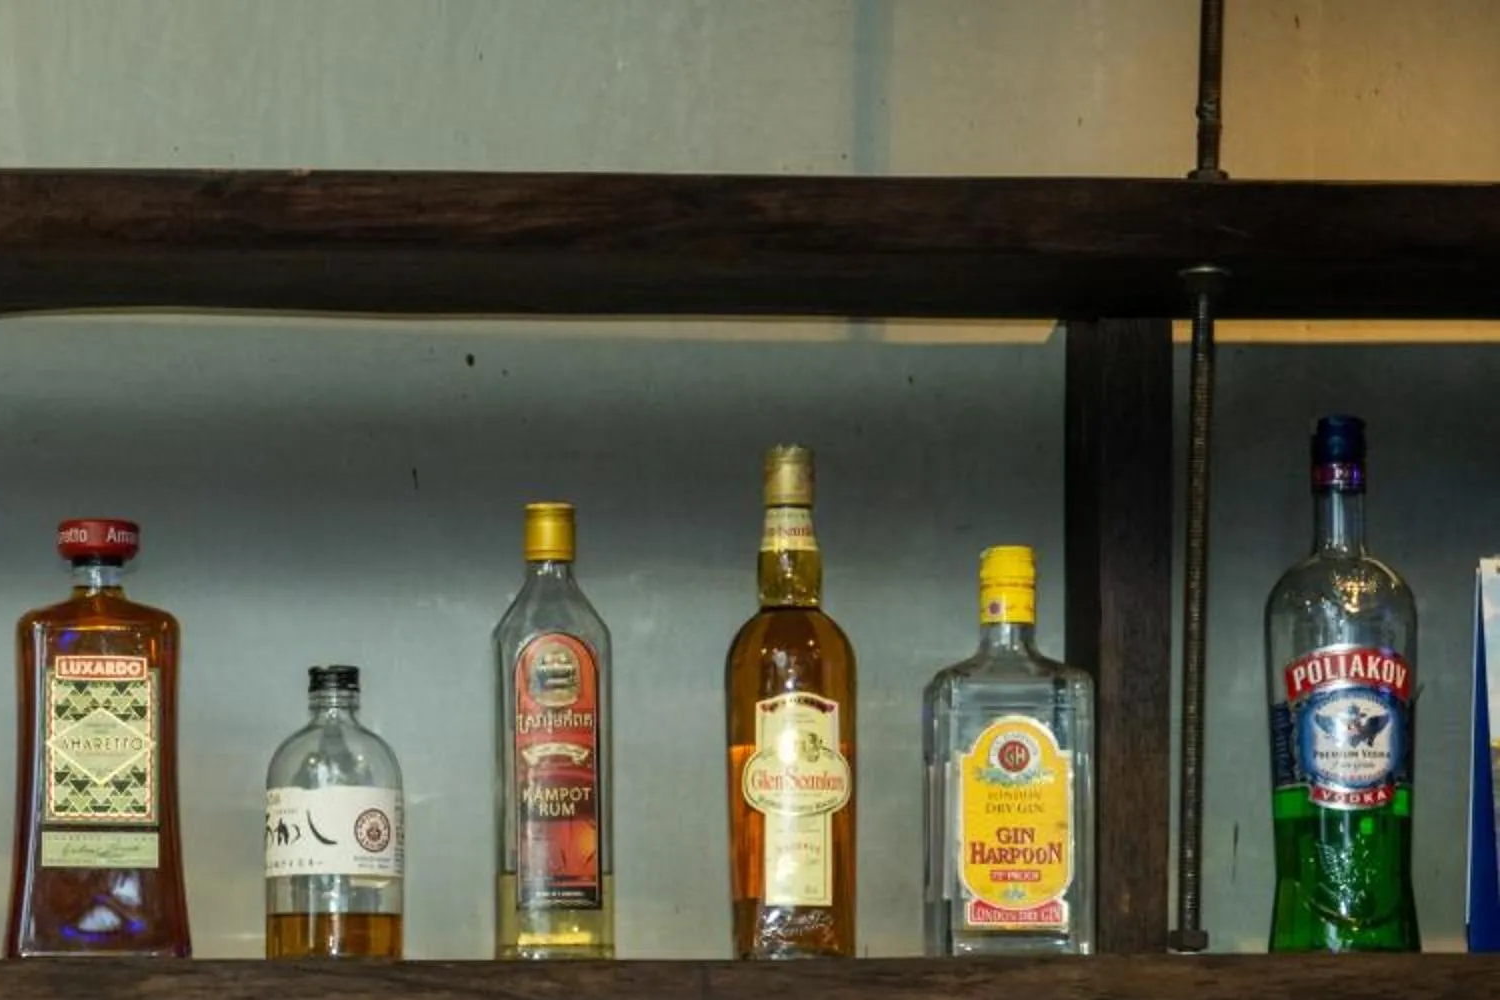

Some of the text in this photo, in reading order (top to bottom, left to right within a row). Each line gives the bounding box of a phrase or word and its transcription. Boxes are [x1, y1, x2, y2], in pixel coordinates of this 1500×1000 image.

[60, 659, 141, 676] LUXARDO
[1292, 653, 1407, 691] POLIAKOV
[523, 786, 592, 801] KAMPOT
[1322, 790, 1388, 804] VODKA
[539, 803, 576, 817] RUM
[995, 827, 1036, 845] GIN
[970, 841, 1063, 865] HARPOON
